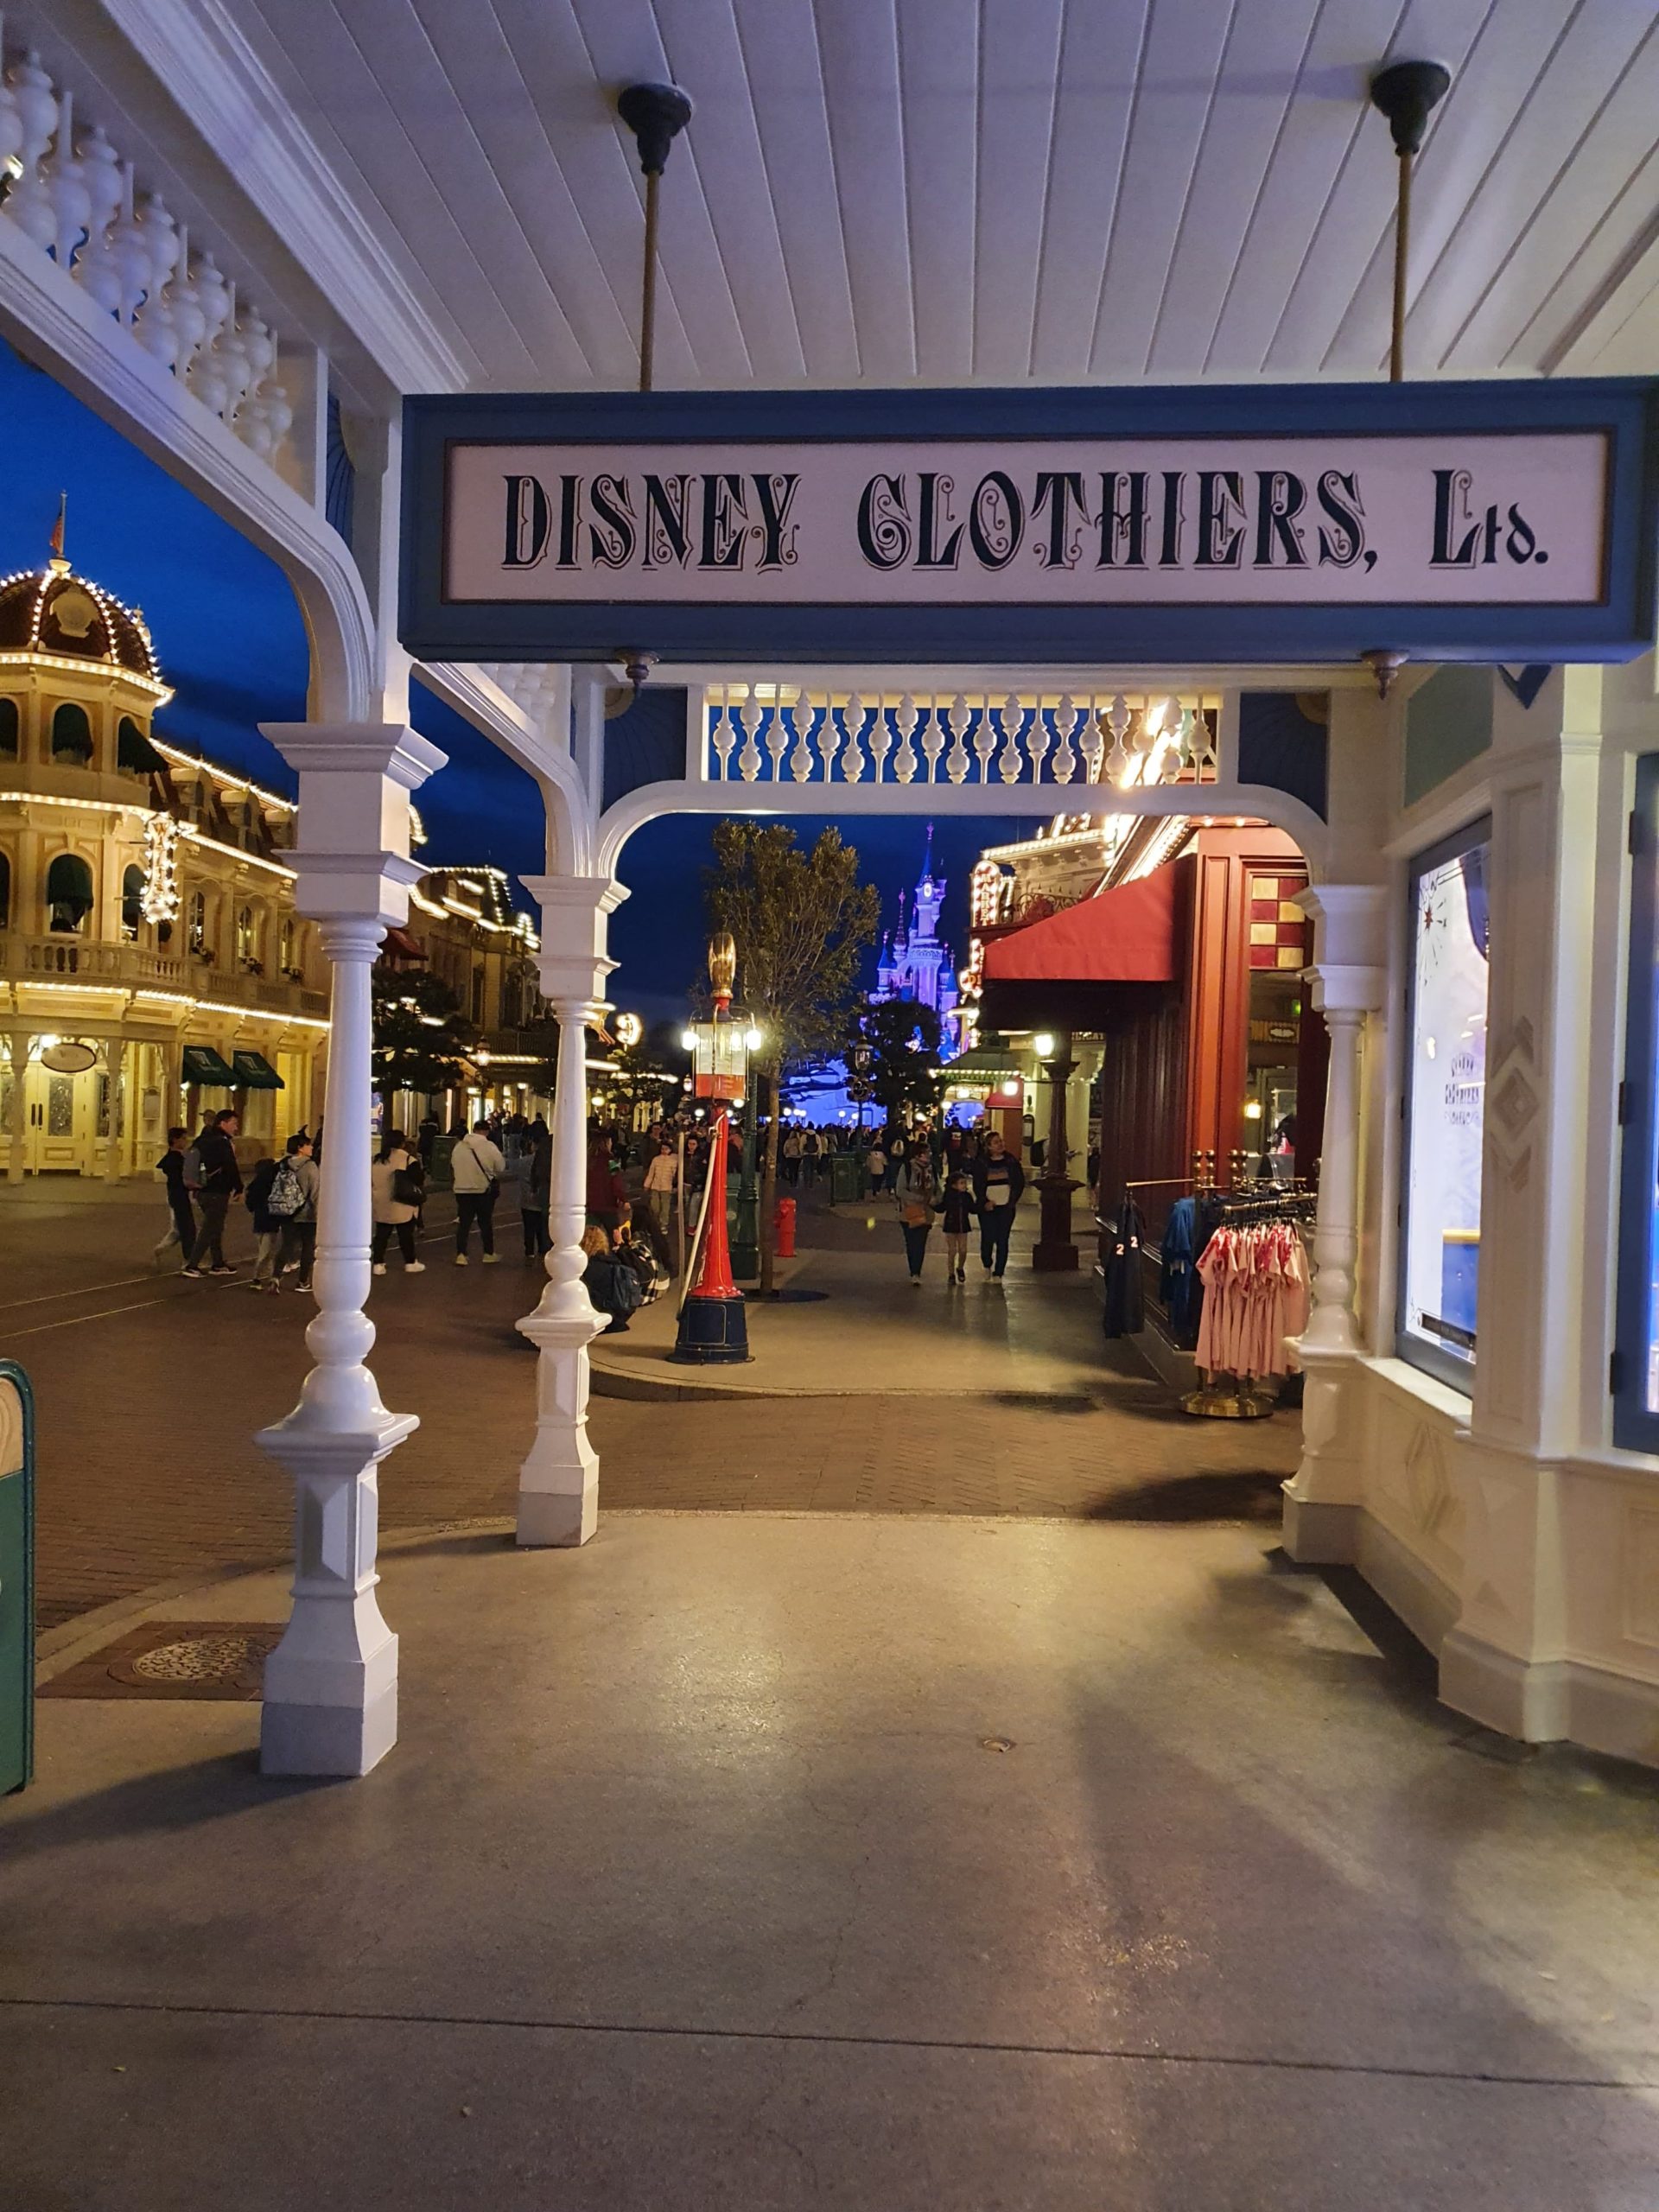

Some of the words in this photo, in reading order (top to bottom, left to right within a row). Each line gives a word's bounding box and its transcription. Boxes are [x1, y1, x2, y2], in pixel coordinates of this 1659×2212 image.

[501, 474, 802, 575] DISNEY
[856, 470, 1378, 574] CLOTHIERS,
[1428, 469, 1549, 570] Ltd.
[1130, 1236, 1139, 1248] 2
[1116, 1243, 1124, 1255] 2
